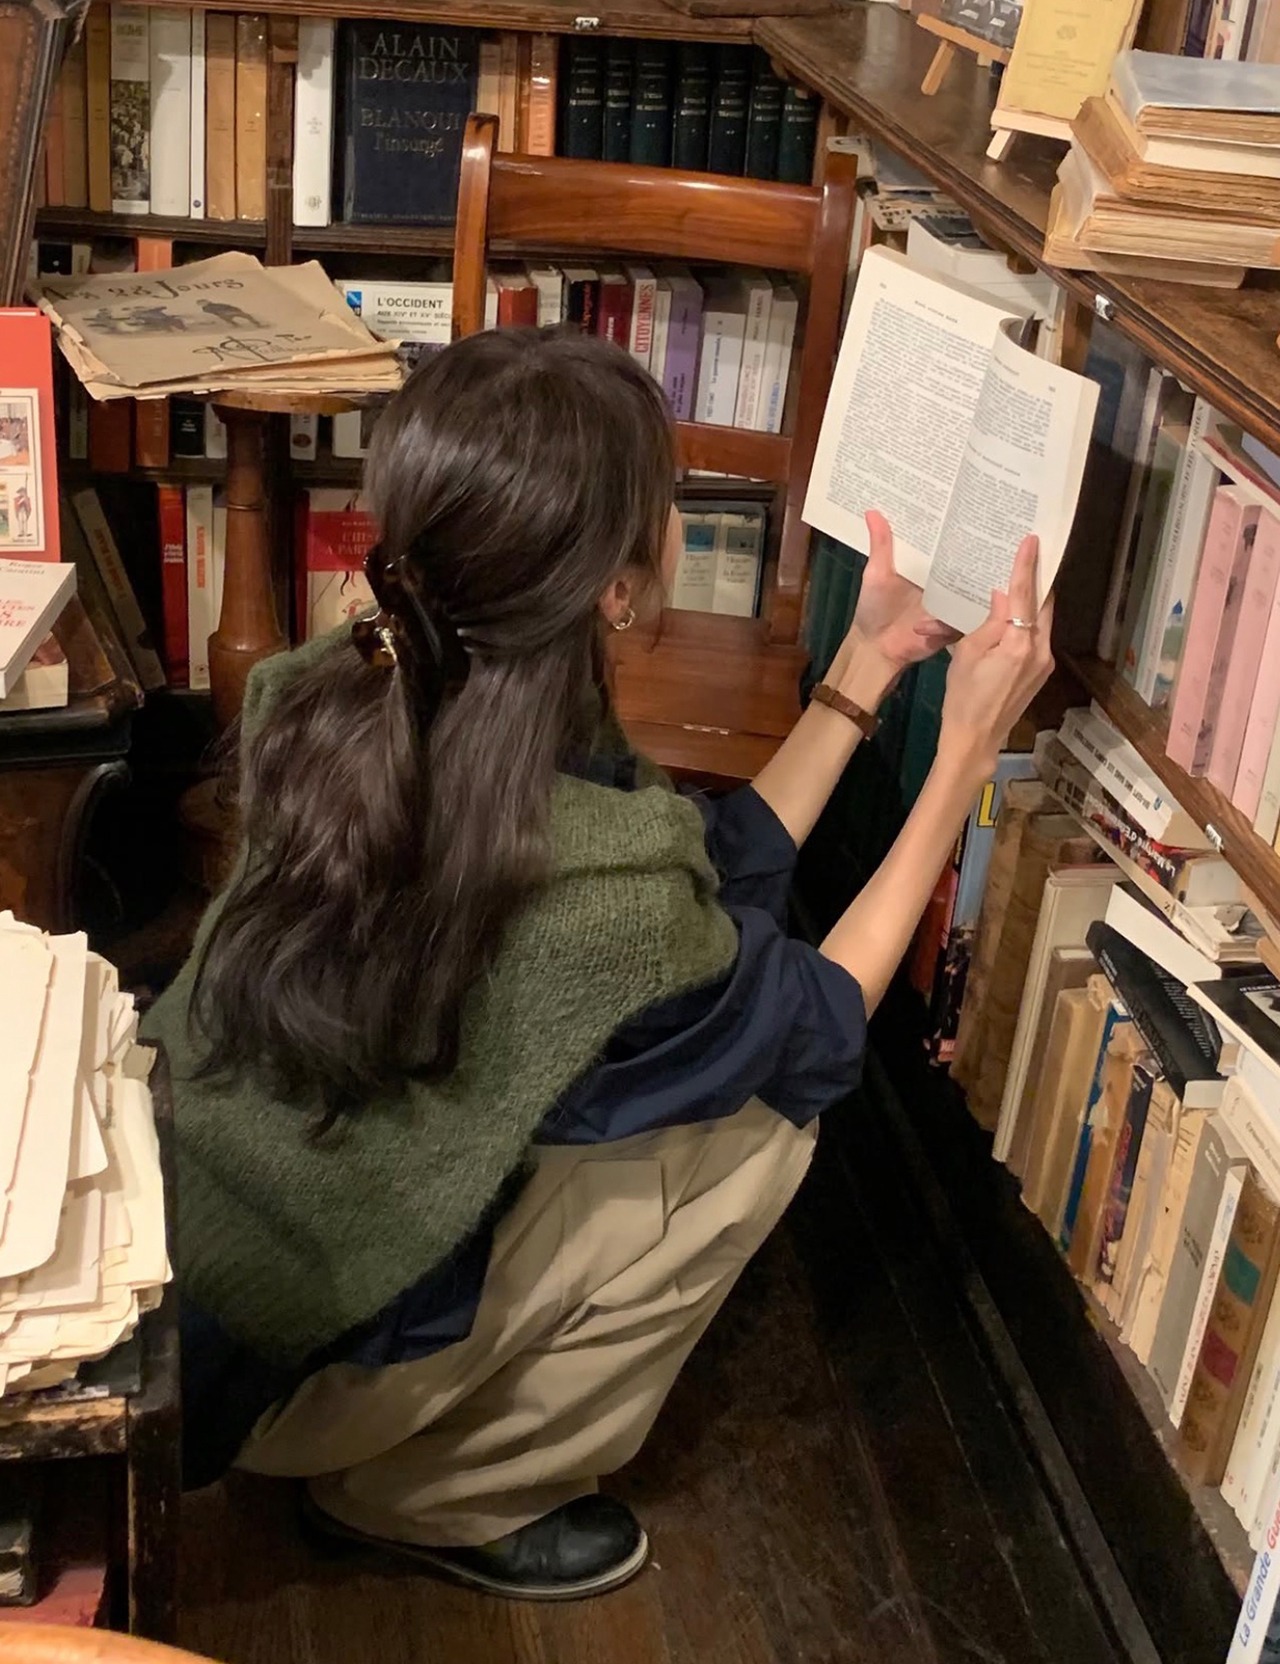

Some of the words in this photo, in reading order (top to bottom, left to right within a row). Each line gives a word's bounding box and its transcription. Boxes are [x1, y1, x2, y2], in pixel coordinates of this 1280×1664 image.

[370, 32, 458, 59] ALAIN
[358, 57, 469, 83] DECAUX
[361, 108, 460, 131] BLANQUI
[151, 278, 244, 299] Jours
[377, 297, 443, 309] L'OCCIDENT
[635, 284, 654, 353] CITOYENNES
[1239, 1622, 1251, 1648] La
[1246, 1552, 1271, 1621] Grande
